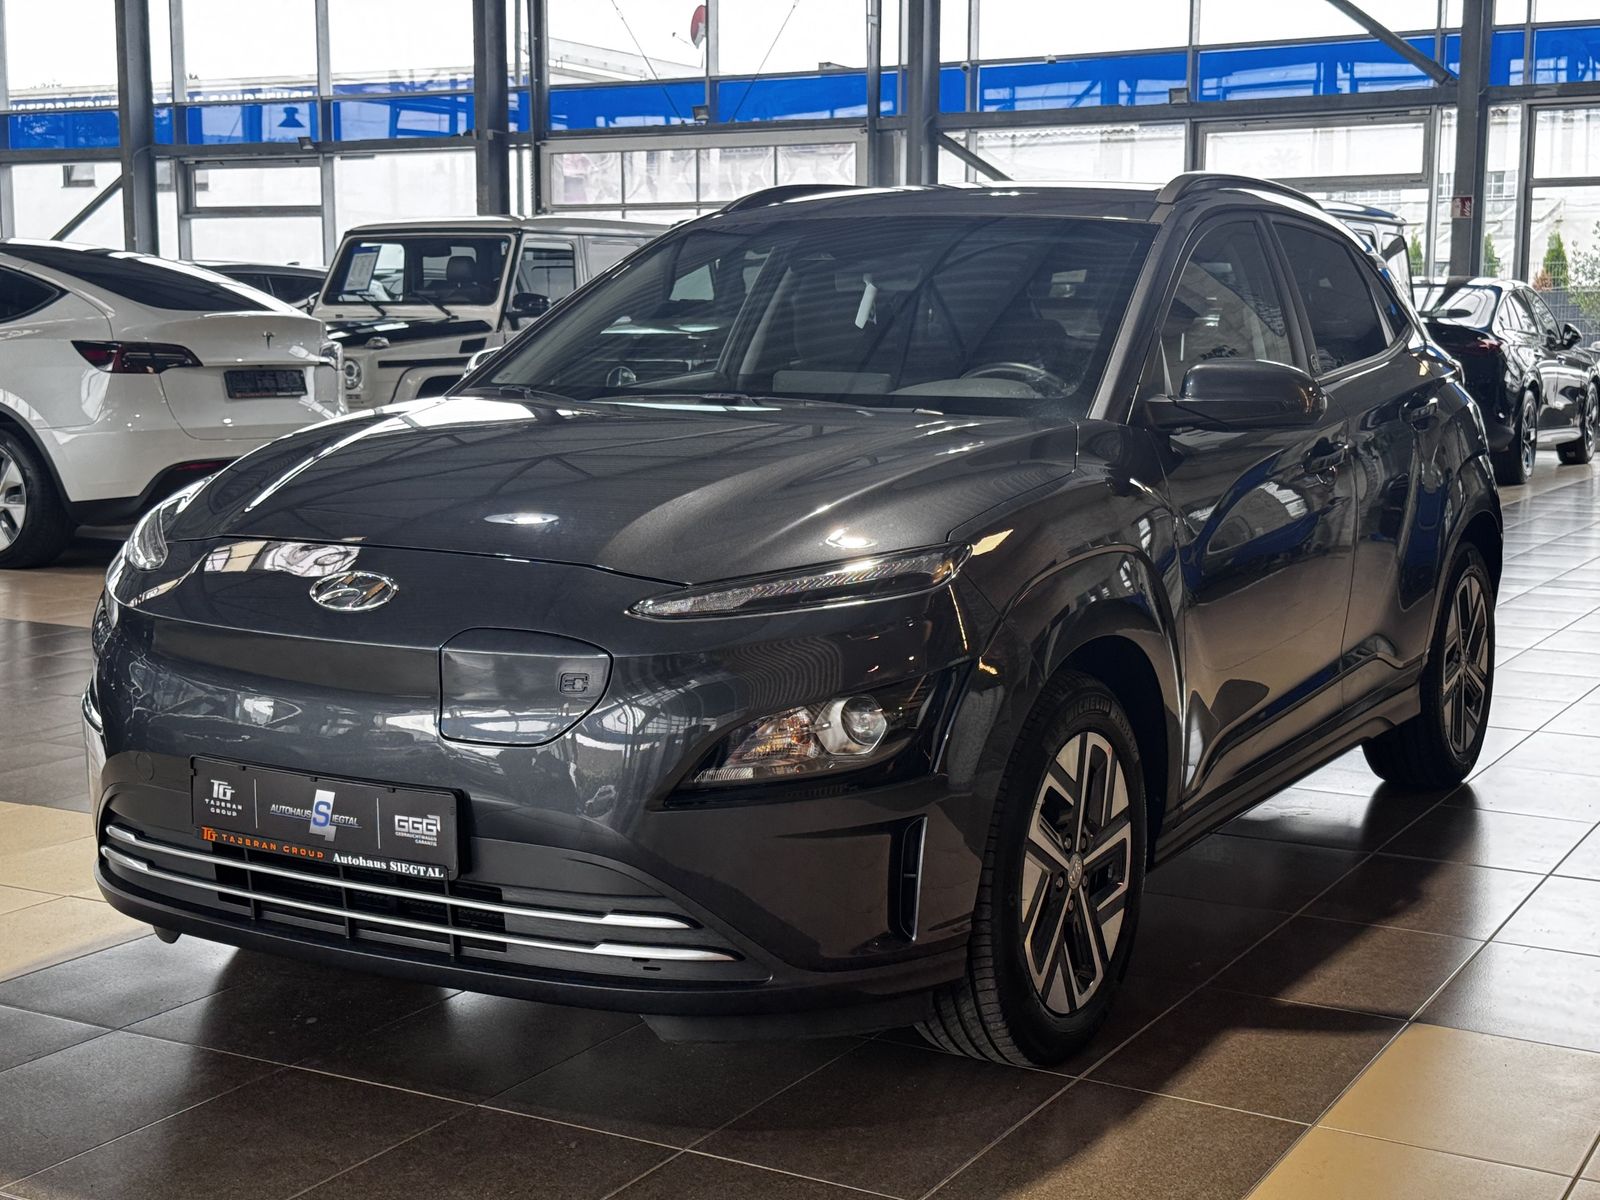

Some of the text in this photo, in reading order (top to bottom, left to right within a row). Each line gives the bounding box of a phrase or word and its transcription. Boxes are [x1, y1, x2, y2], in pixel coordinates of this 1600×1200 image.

[210, 807, 237, 817] GROUP
[270, 803, 312, 818] AUTOHAUS
[394, 814, 441, 836] GGG
[282, 845, 324, 859] GROUP
[333, 853, 444, 878] Autohaus SIEGTAL
